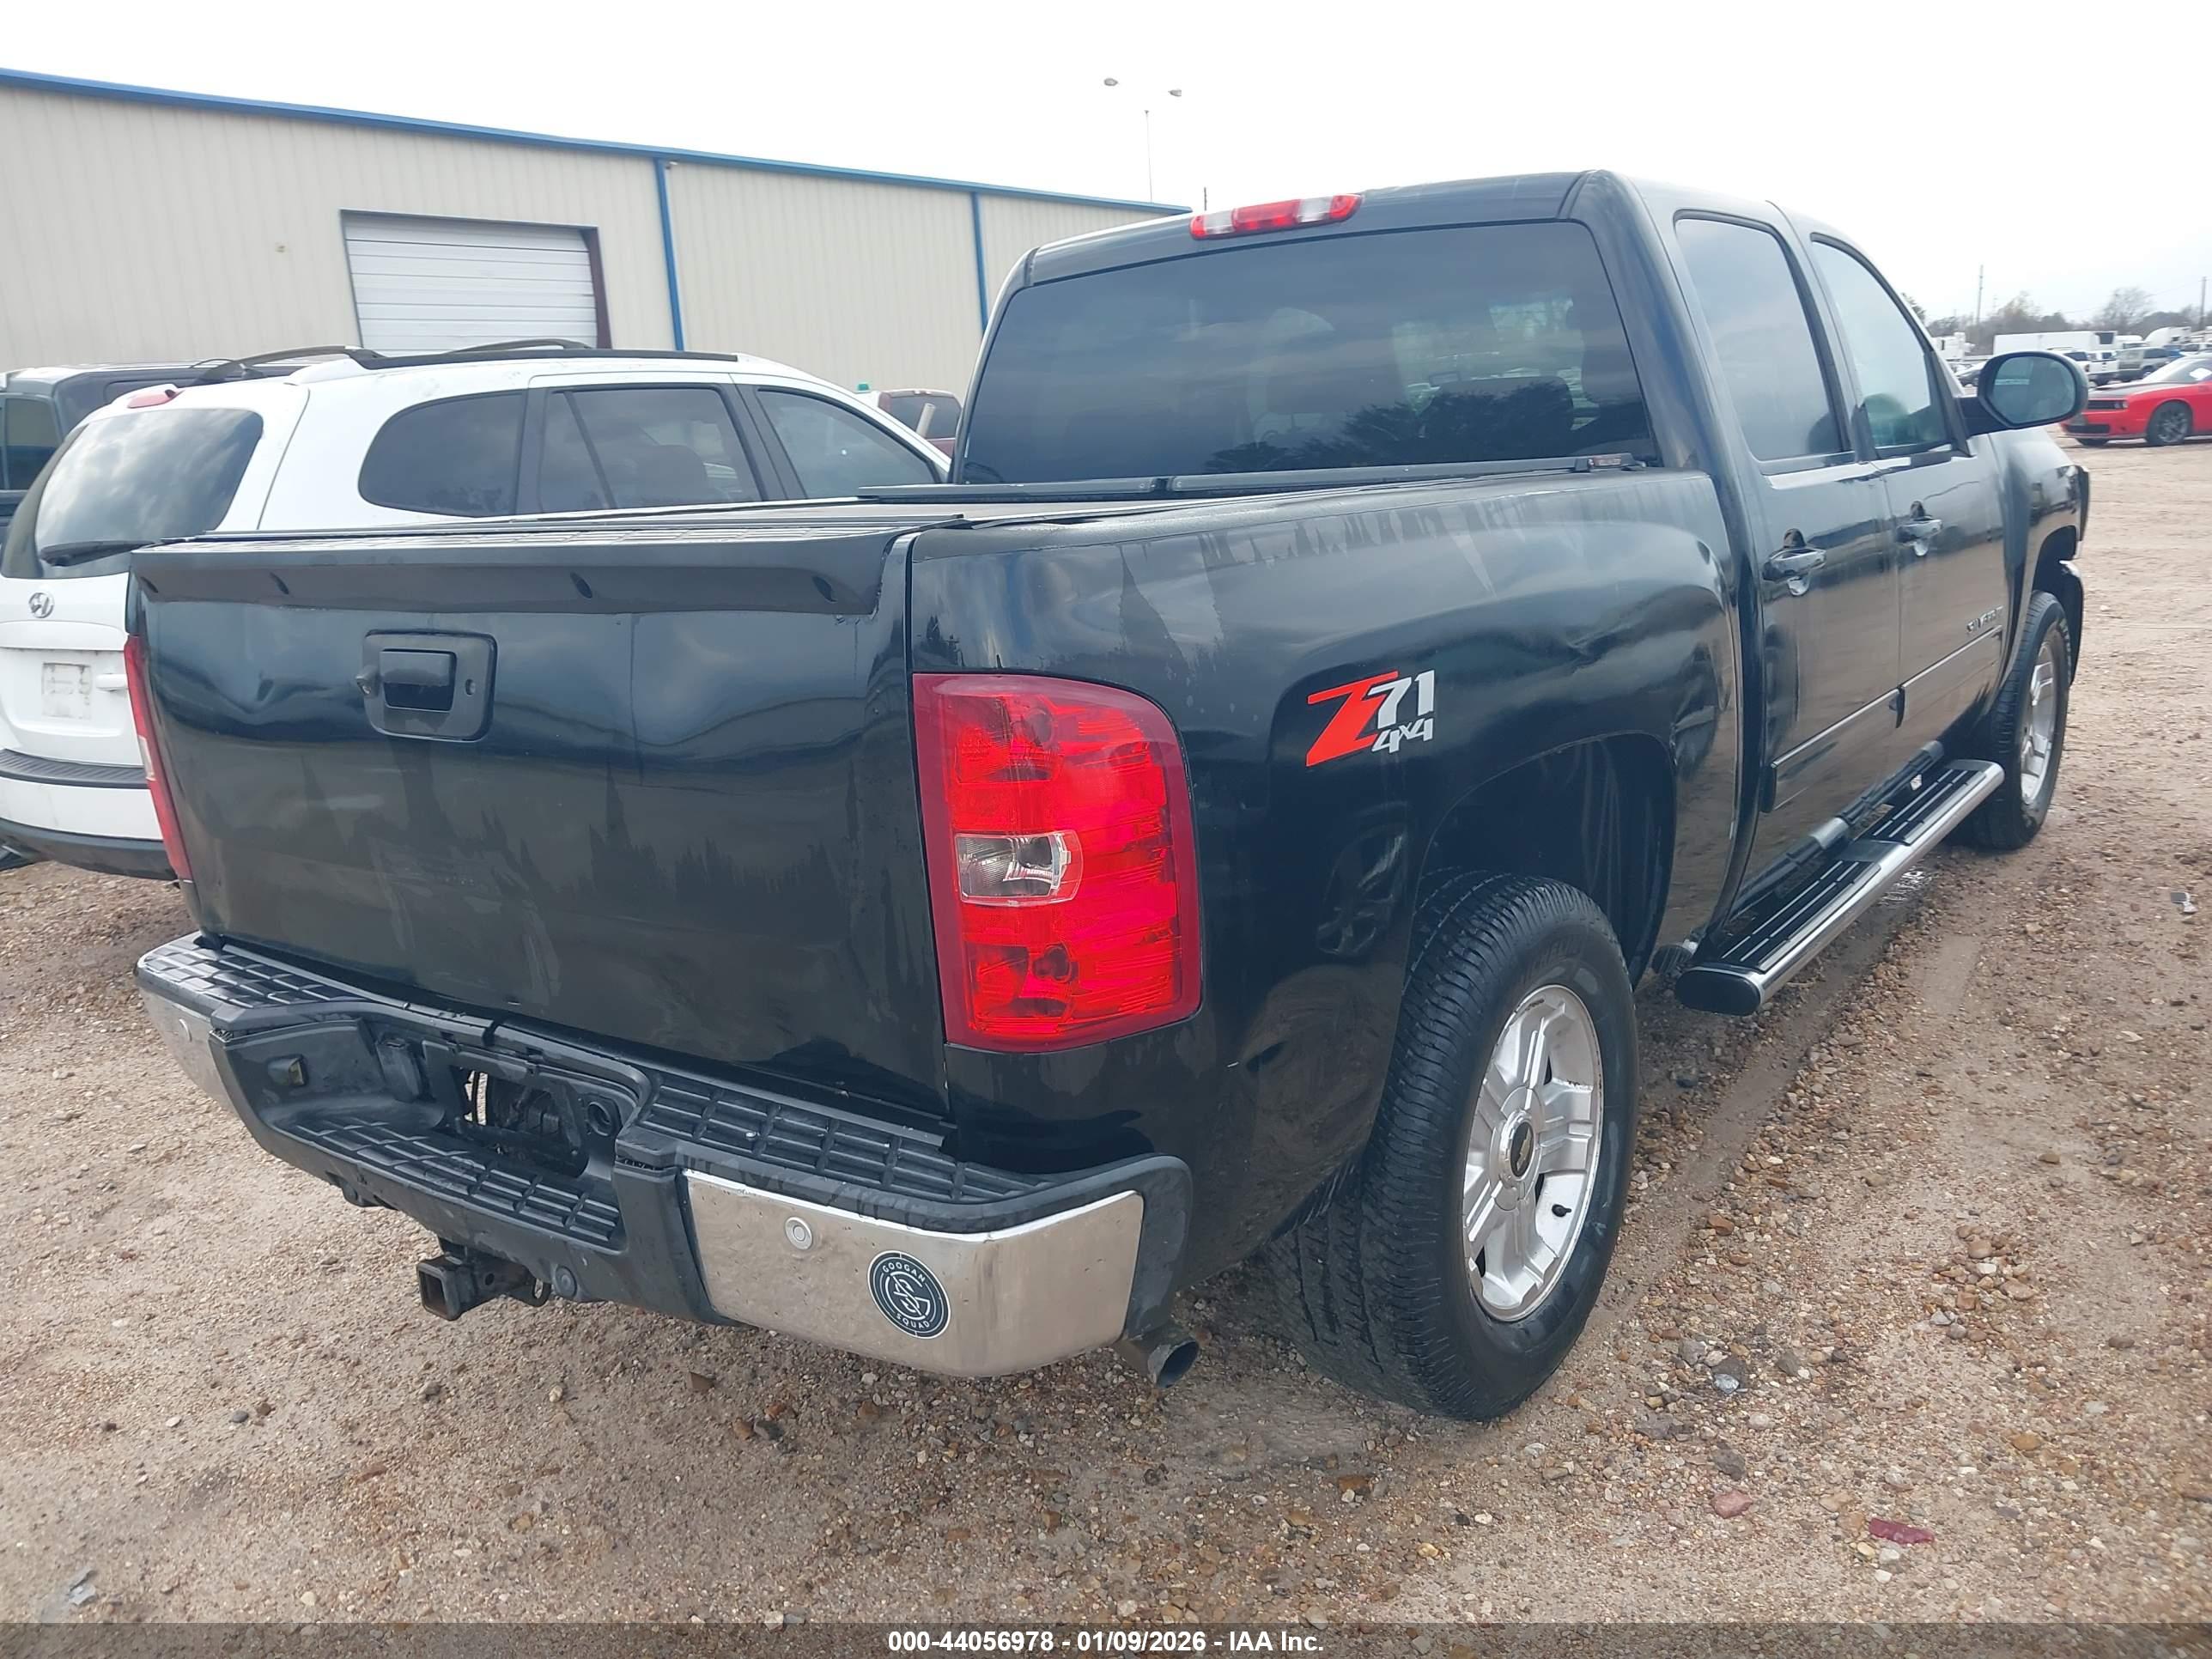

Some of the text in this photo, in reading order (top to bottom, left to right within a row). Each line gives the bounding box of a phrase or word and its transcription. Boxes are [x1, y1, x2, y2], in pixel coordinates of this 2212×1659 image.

[1306, 670, 1436, 767] Z71
[882, 1261, 927, 1283] GOOGAN
[896, 1312, 931, 1329] SQUAD
